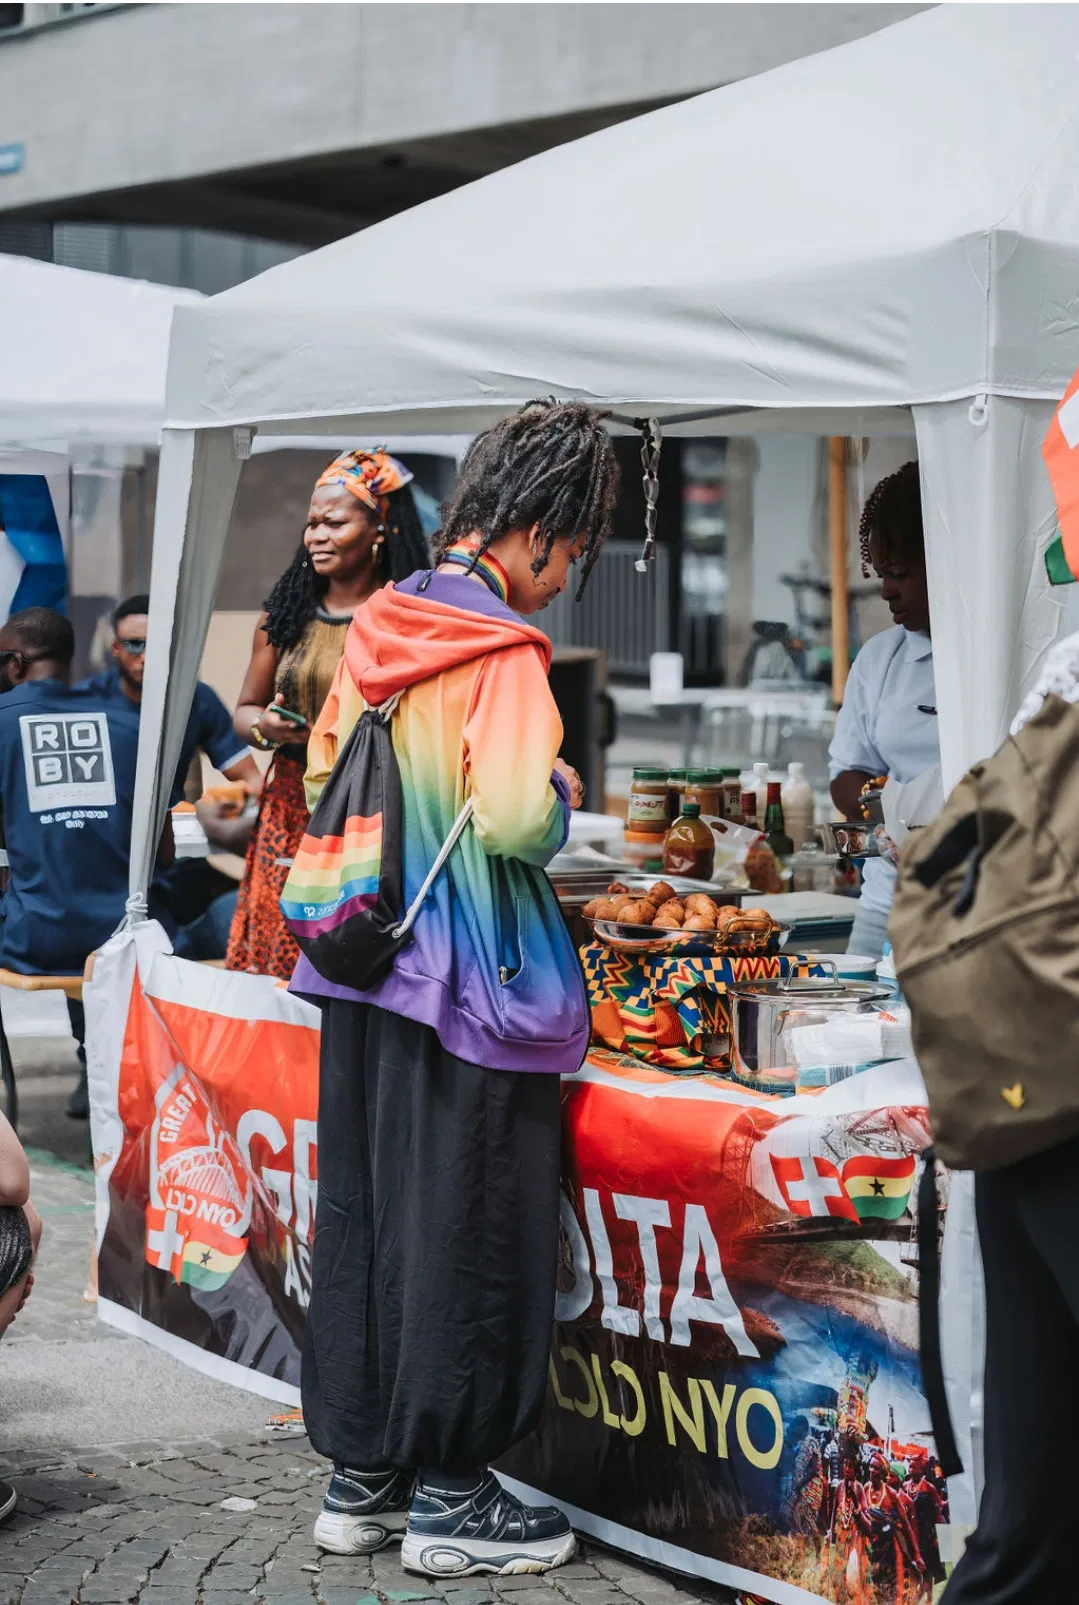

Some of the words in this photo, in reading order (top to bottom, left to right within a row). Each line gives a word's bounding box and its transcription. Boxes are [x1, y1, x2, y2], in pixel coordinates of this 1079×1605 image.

[160, 1082, 198, 1143] GREAT
[196, 1199, 236, 1229] NYO
[658, 1371, 783, 1470] NYO
